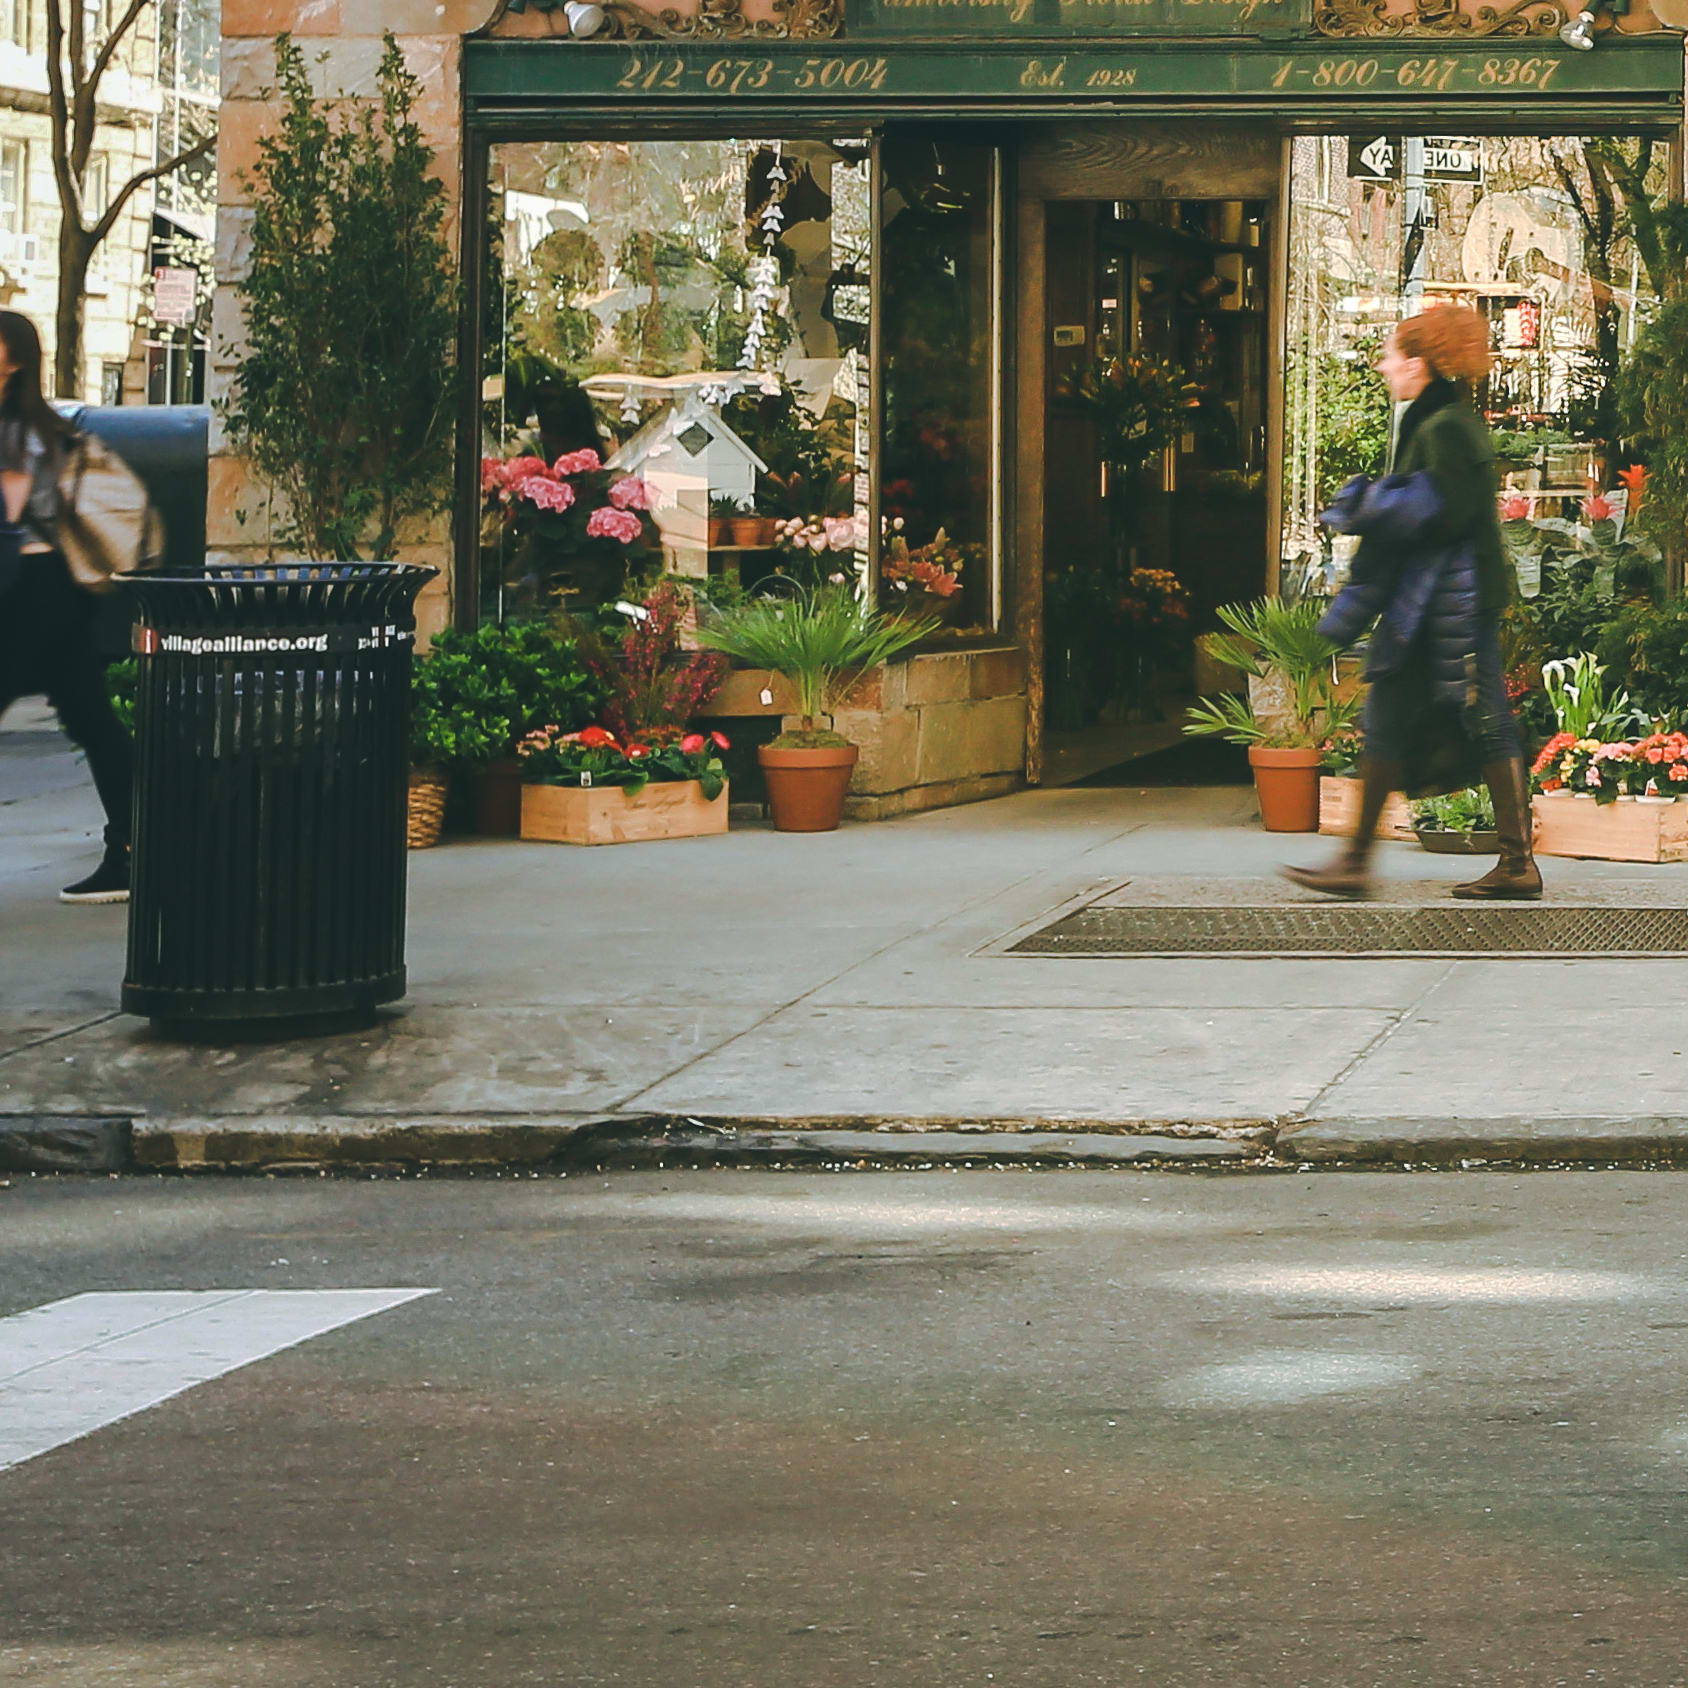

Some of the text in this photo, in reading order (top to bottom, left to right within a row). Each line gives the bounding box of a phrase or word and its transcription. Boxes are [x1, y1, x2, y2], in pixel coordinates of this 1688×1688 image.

[616, 58, 1561, 94] 212-673-5004 Est. 1928 1-800-647-8367
[161, 634, 329, 654] villagealliance.org
